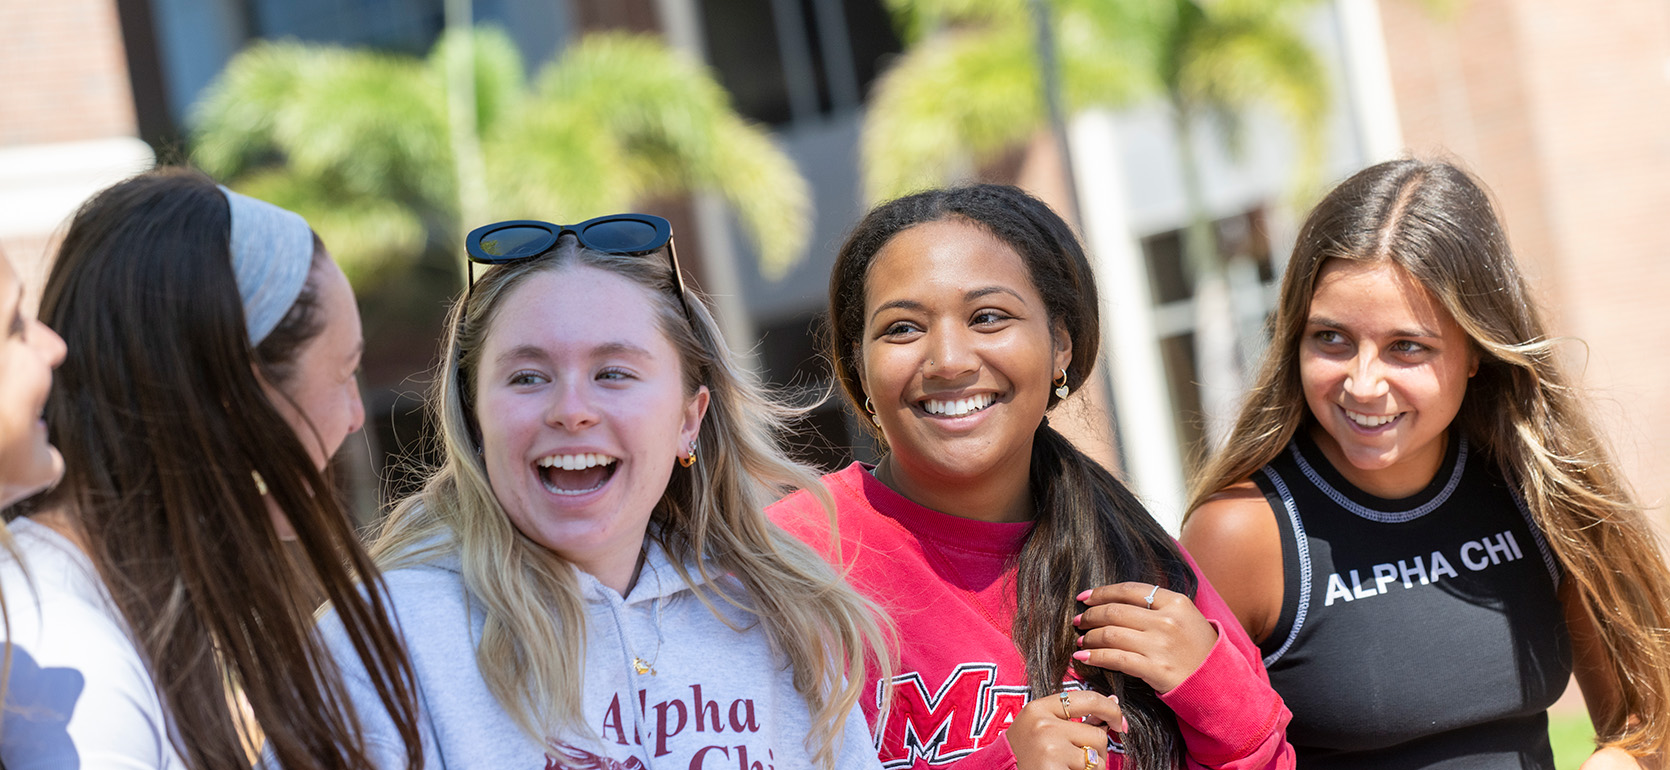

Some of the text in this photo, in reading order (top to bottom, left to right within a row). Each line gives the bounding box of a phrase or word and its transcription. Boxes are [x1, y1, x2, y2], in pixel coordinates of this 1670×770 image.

[1324, 530, 1524, 607] ALPHA CHI
[601, 683, 761, 758] Alpha
[875, 662, 1084, 770] MA
